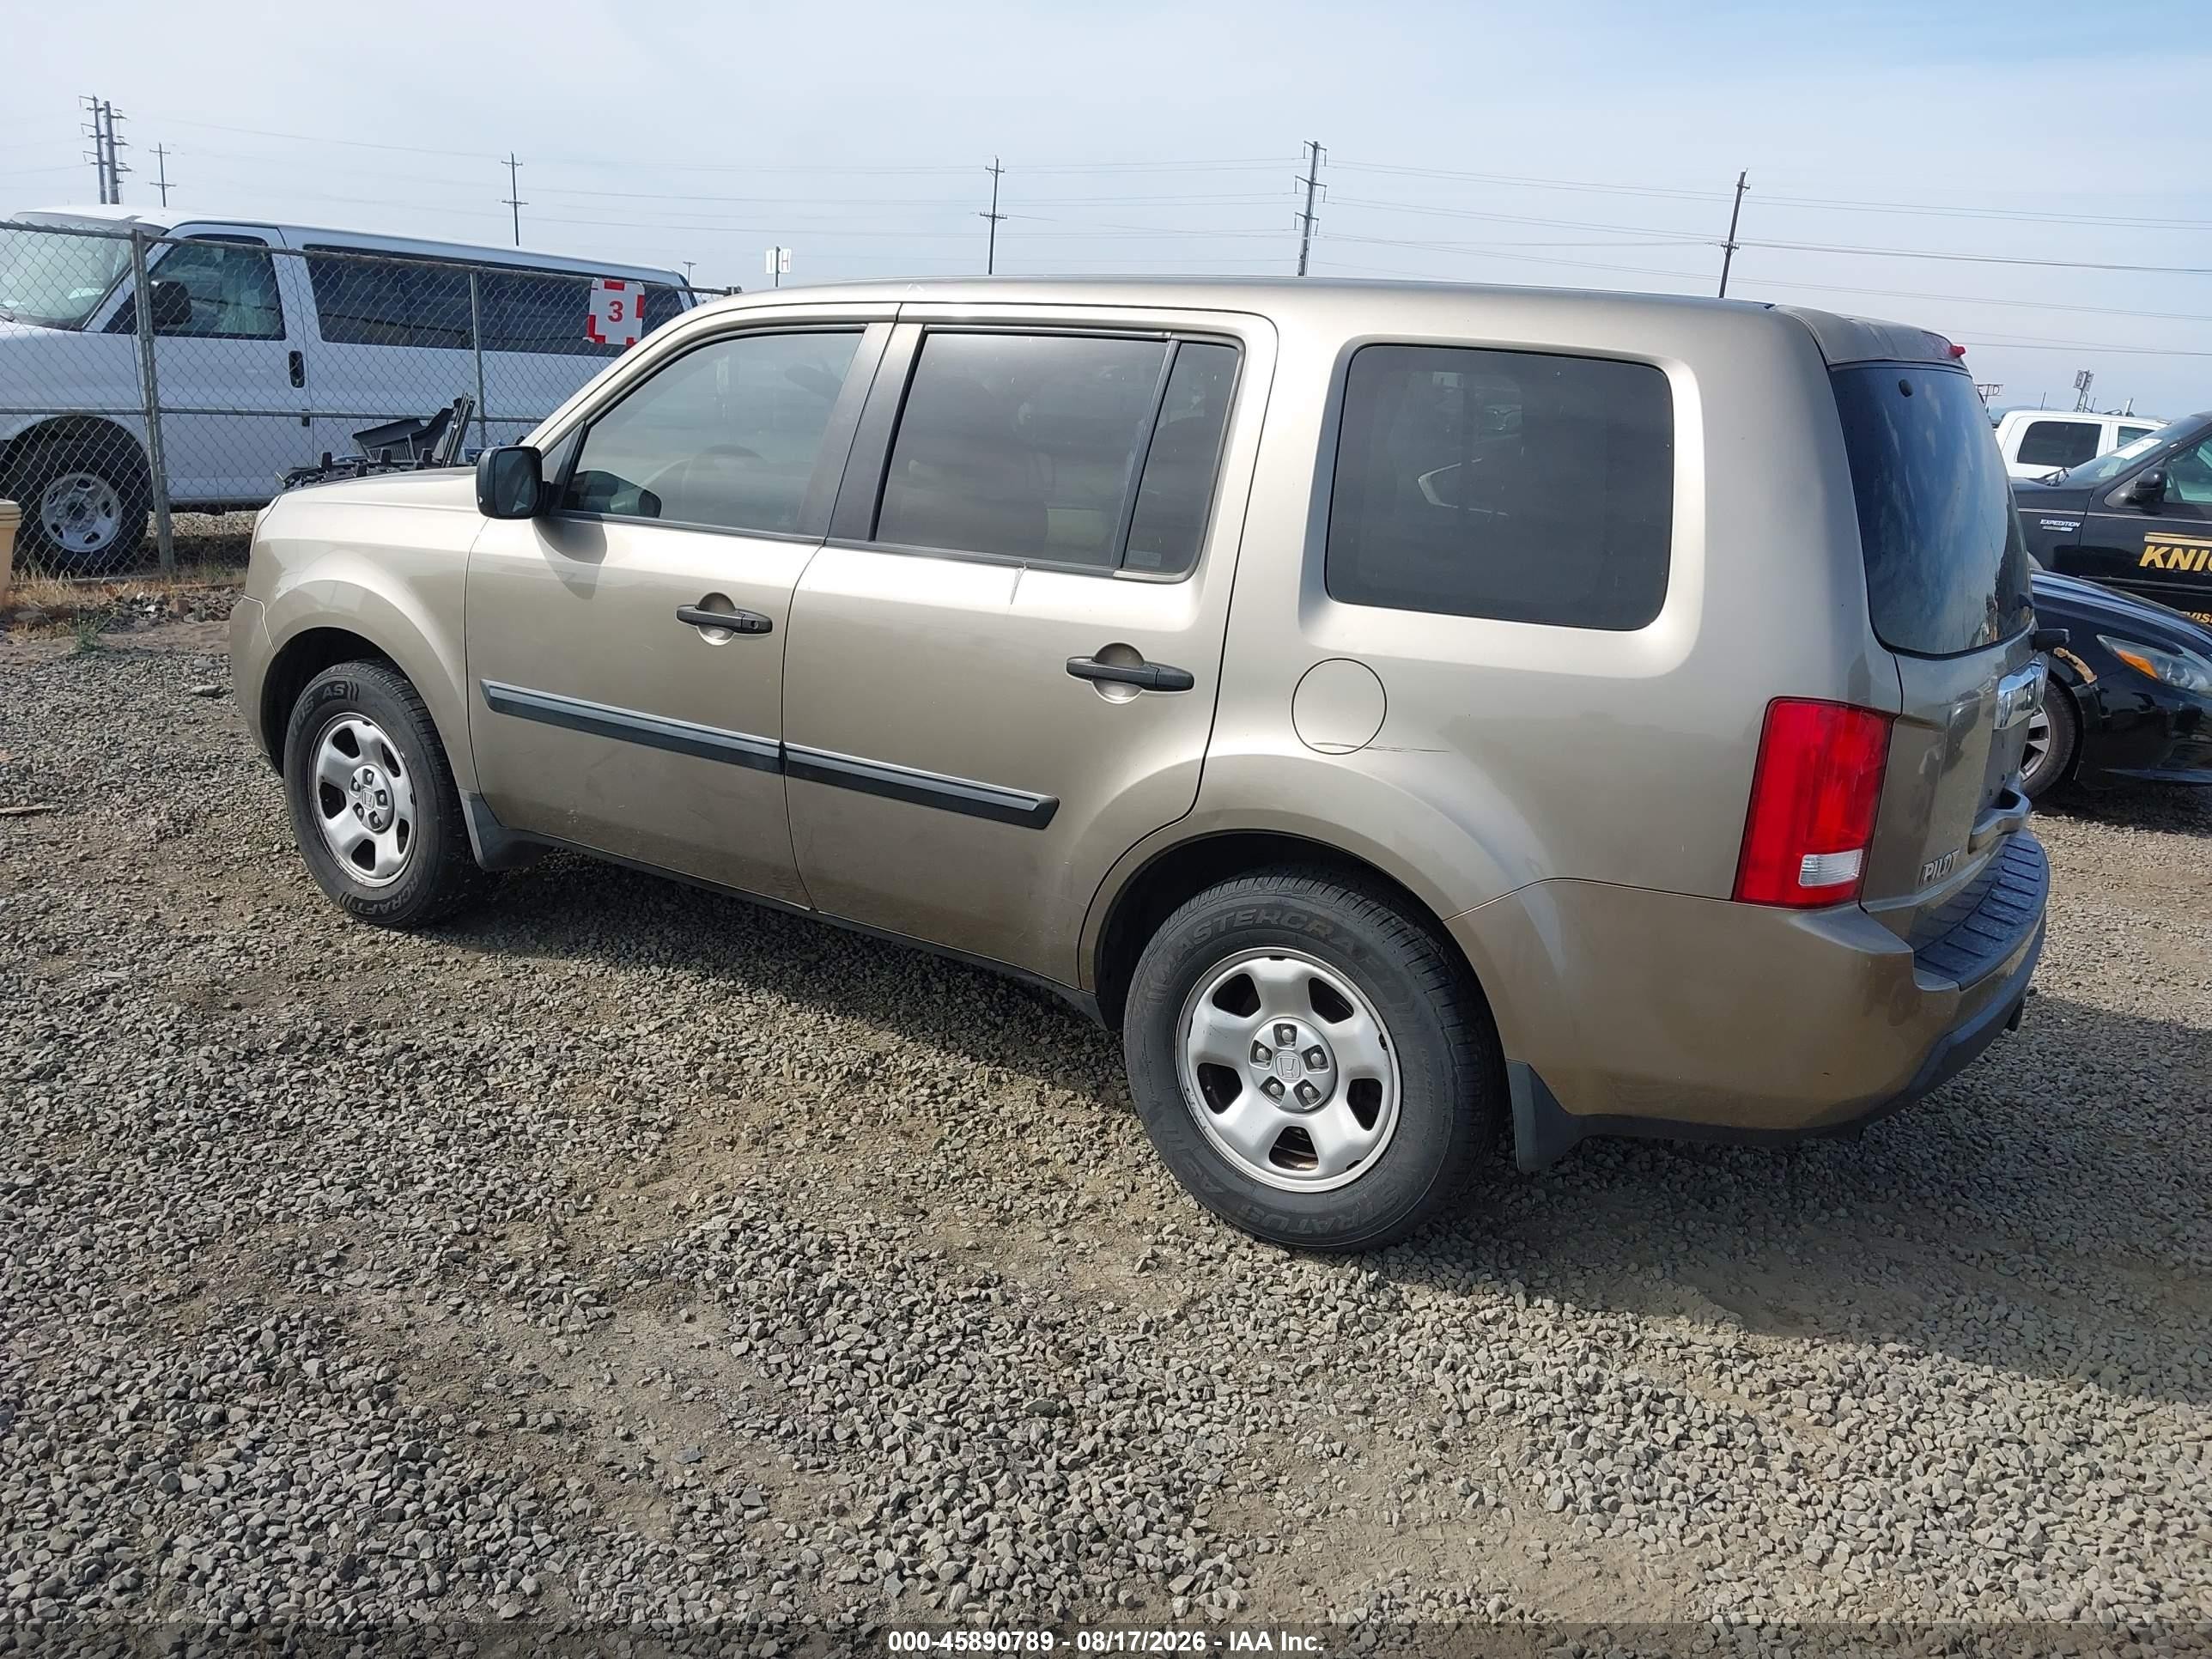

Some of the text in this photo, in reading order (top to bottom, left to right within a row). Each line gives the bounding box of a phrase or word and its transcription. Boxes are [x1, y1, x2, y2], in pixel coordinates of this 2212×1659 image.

[606, 300, 624, 323] 3
[2138, 545, 2212, 573] KNI
[1917, 848, 1960, 886] PILOT
